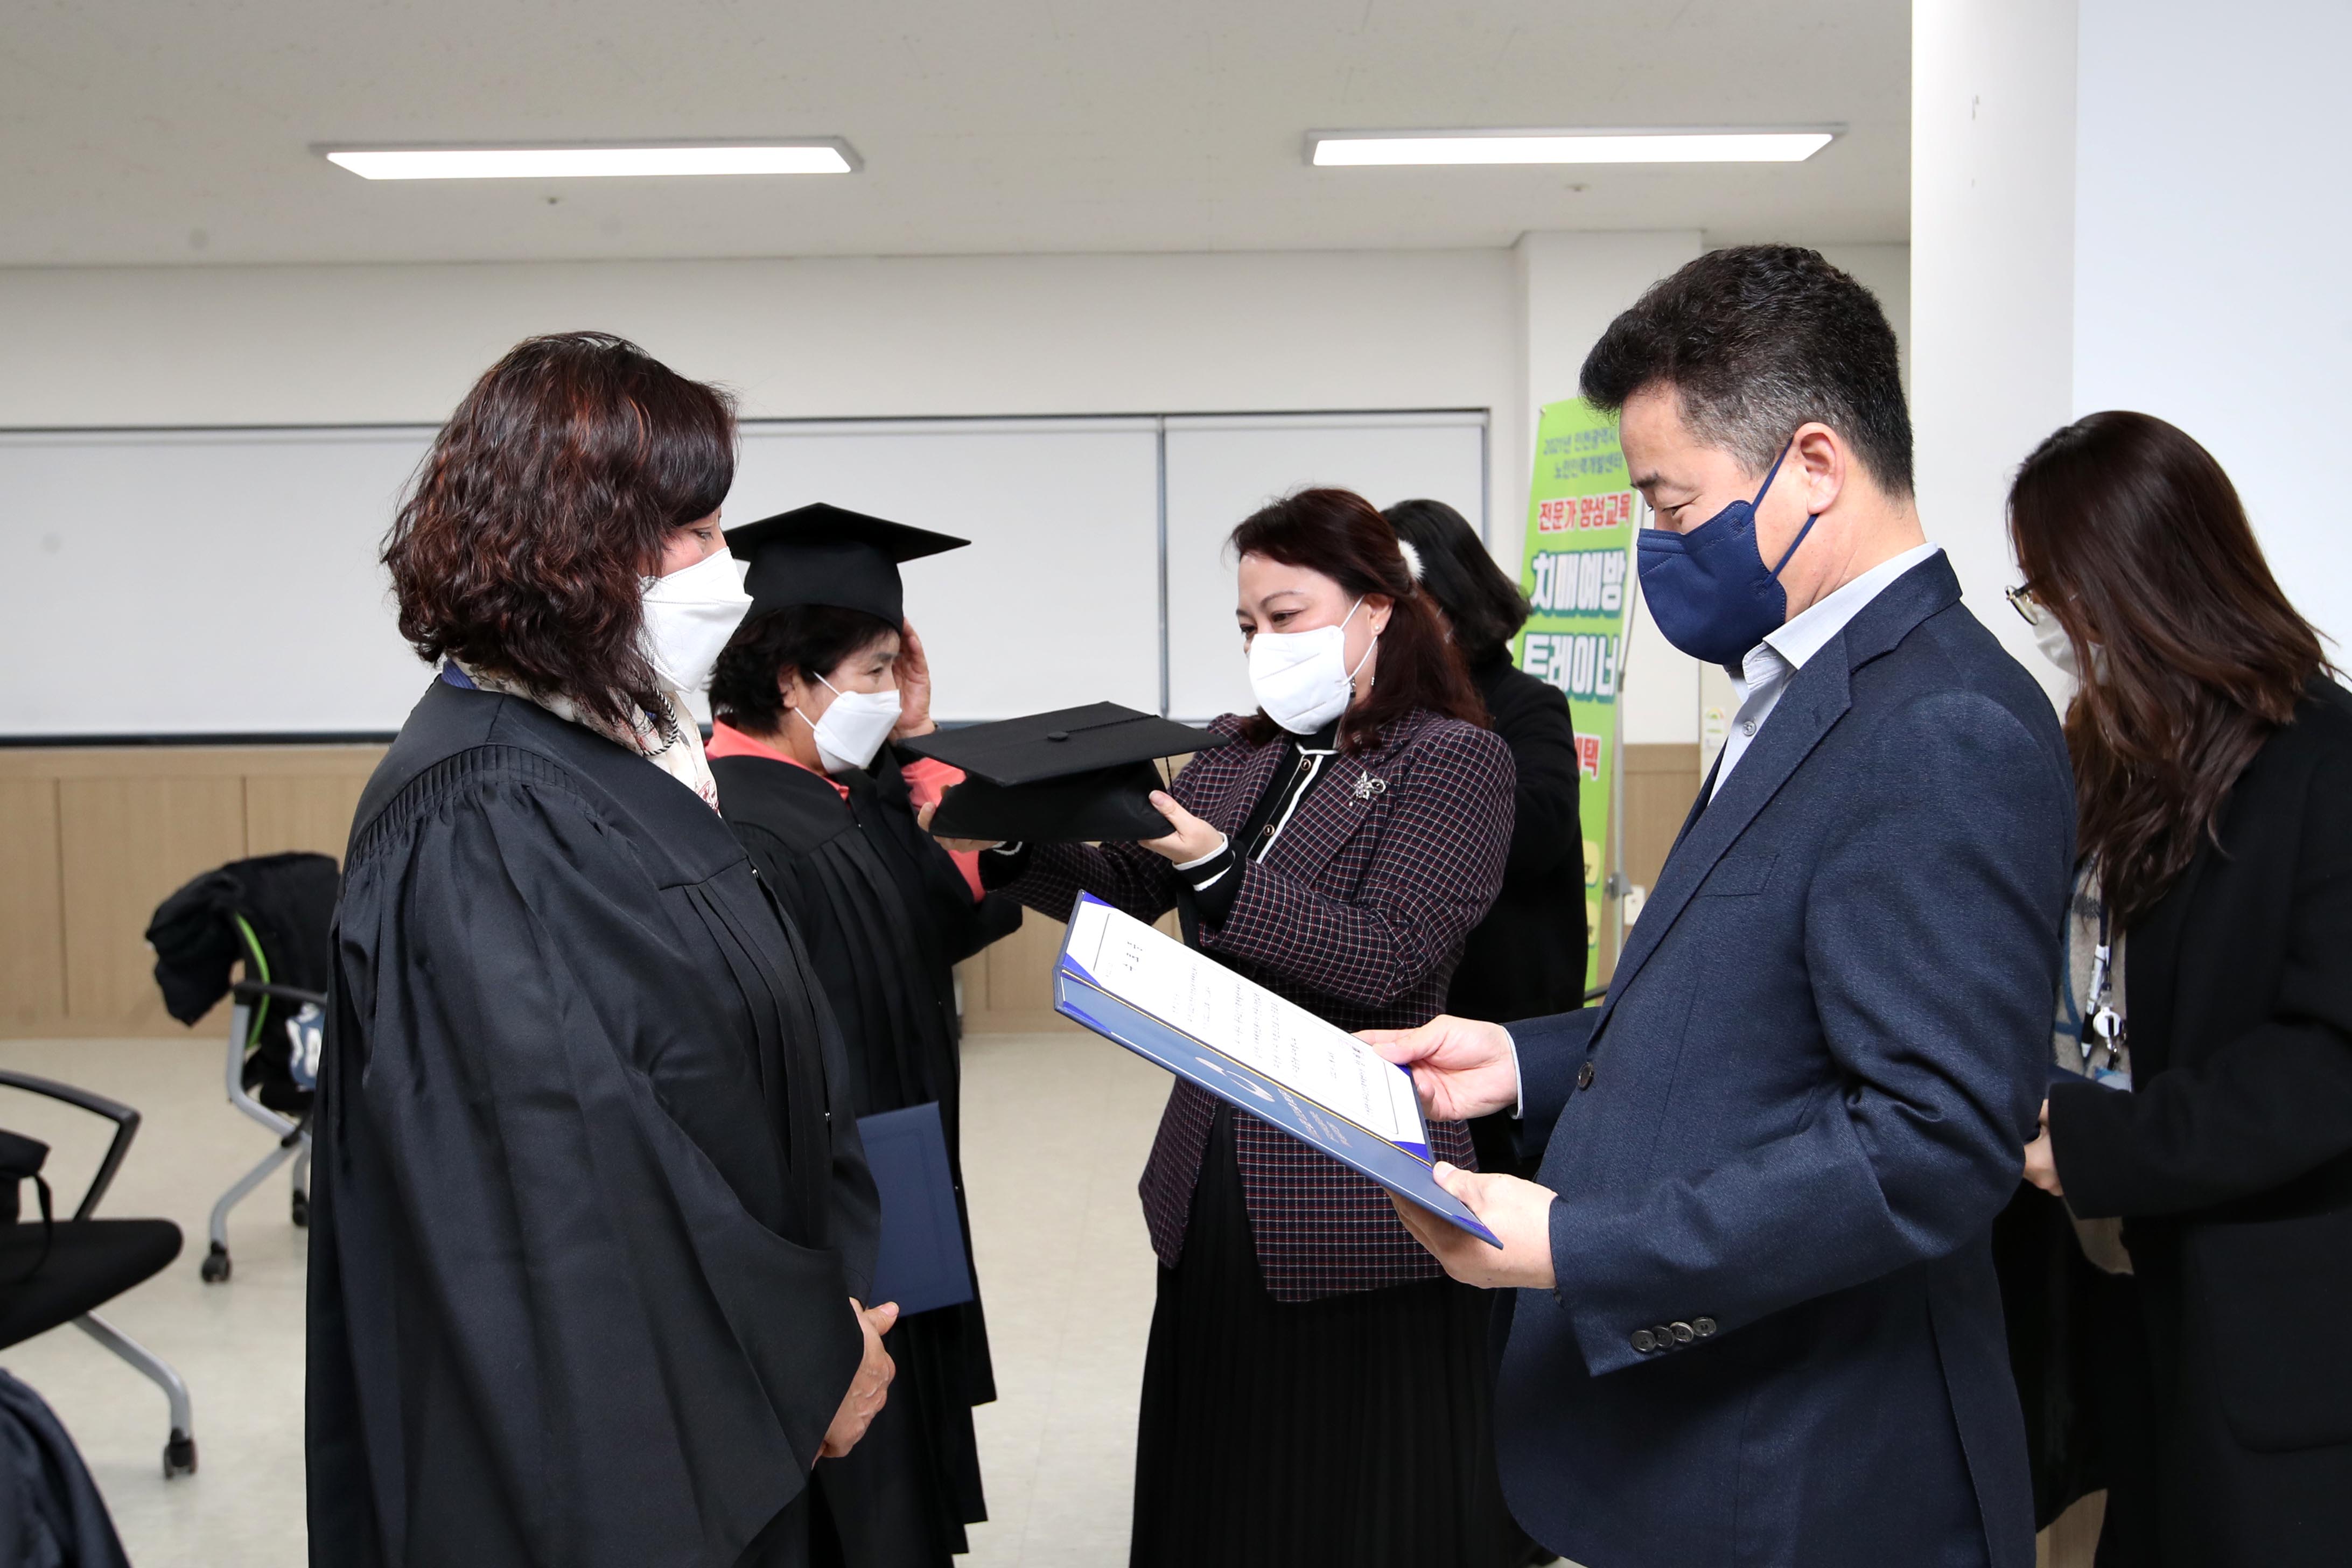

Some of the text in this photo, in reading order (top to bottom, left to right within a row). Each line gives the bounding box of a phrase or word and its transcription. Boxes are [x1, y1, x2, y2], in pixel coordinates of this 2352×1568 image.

[1539, 491, 1632, 533] 전문가 양성교육
[1531, 548, 1627, 615] 치매예방
[1522, 632, 1619, 701] 트레이너
